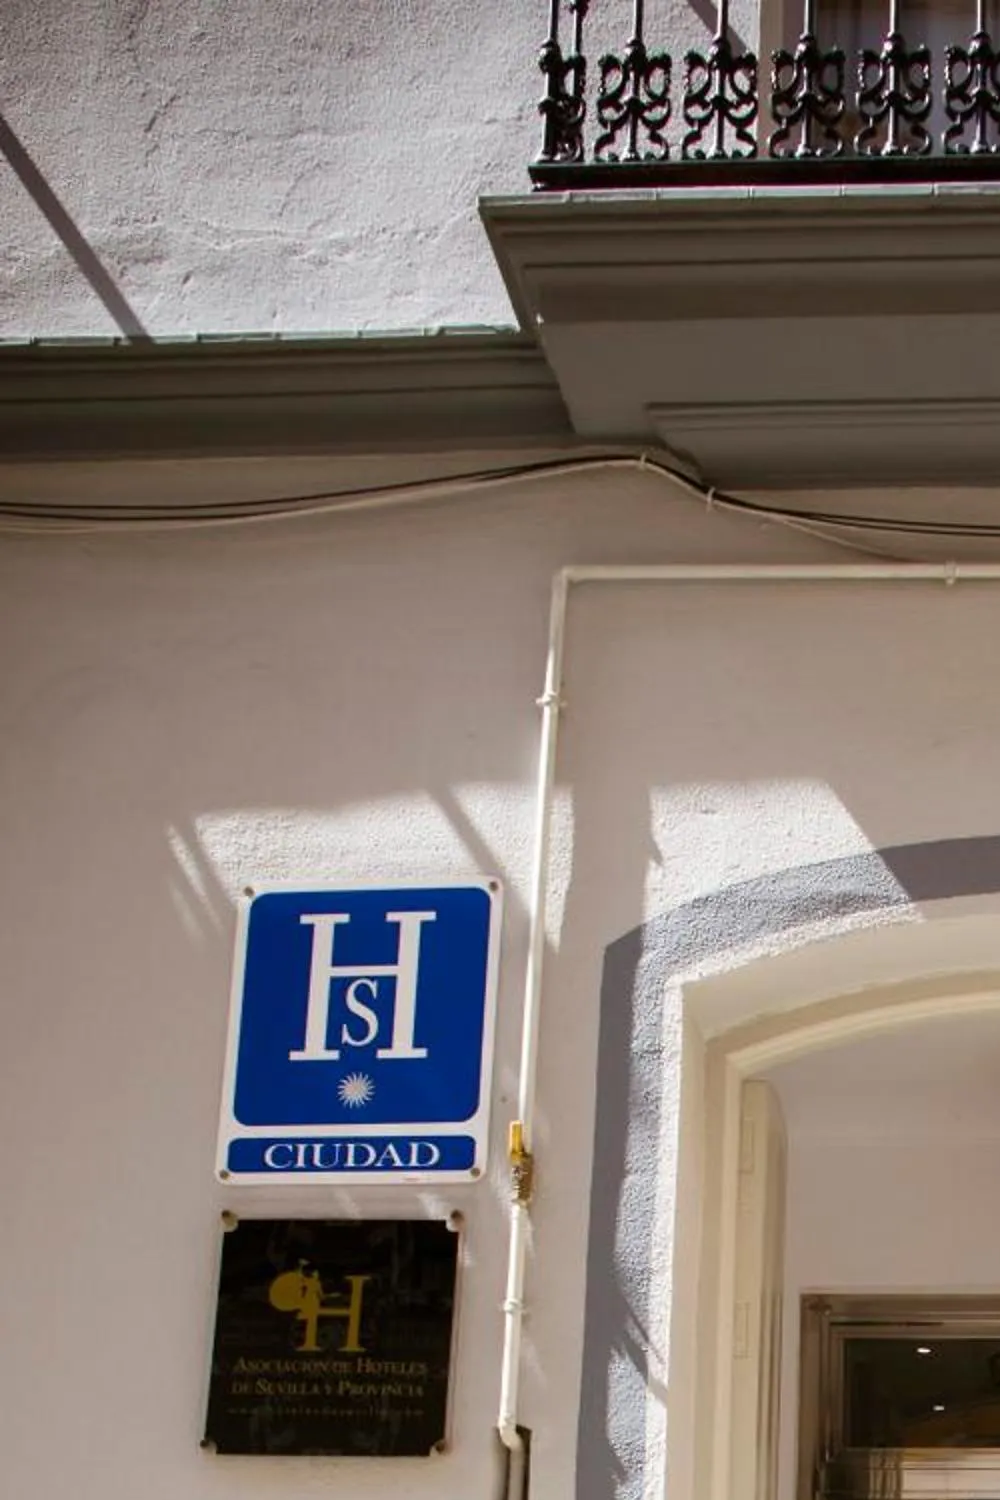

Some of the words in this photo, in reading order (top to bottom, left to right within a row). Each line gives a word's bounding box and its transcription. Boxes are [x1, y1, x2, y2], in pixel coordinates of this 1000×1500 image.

[263, 1141, 441, 1169] CIUDAD
[357, 1357, 428, 1374] HOTELES
[255, 1378, 321, 1396] SEVILLA
